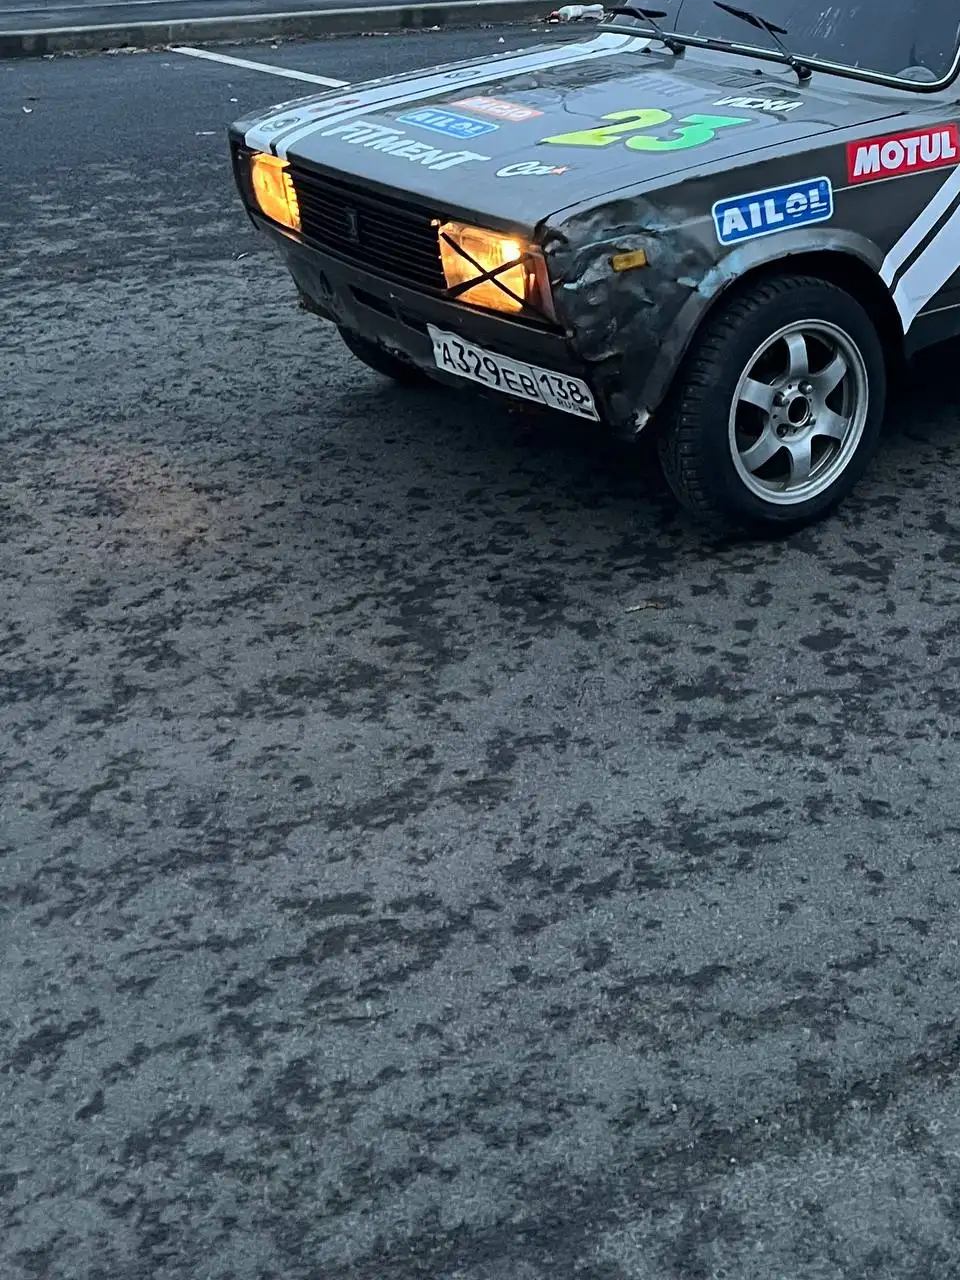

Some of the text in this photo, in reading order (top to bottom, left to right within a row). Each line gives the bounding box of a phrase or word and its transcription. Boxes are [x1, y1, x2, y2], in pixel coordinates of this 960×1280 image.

[321, 120, 492, 171] FITMENT
[540, 108, 752, 152] 23
[853, 130, 957, 177] MOTUL
[722, 187, 828, 237] AILOL
[540, 374, 584, 404] 138
